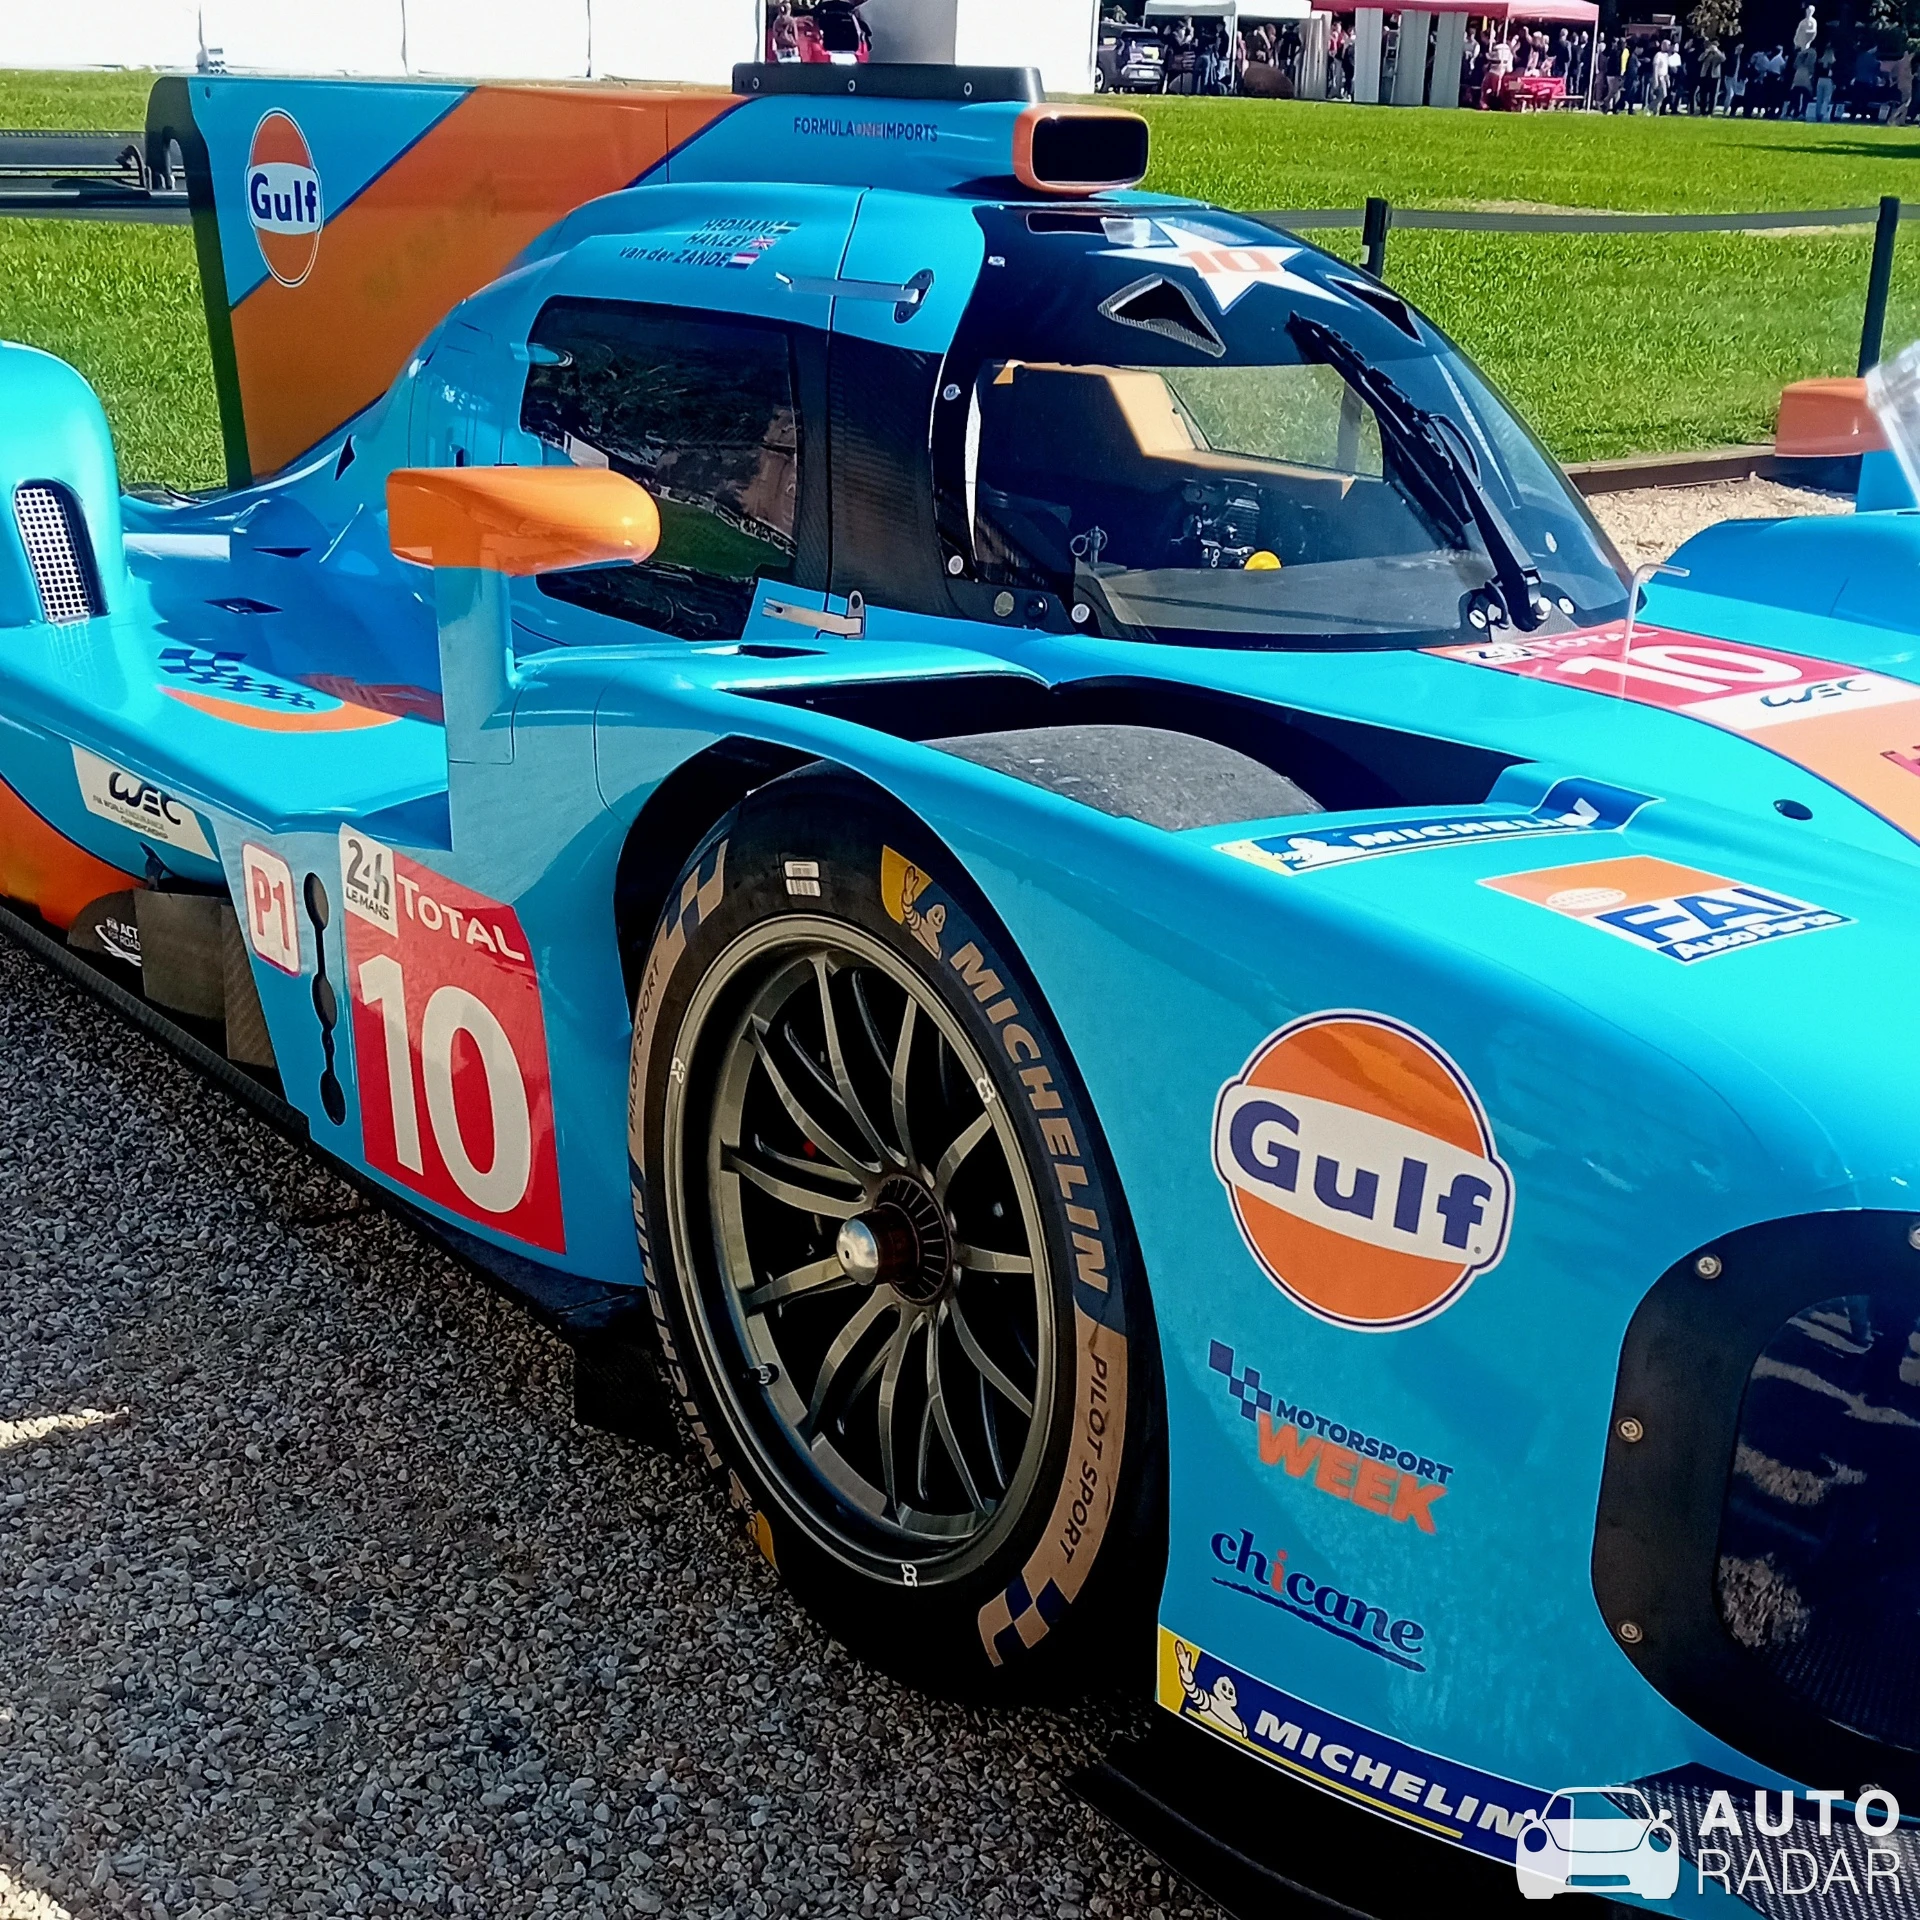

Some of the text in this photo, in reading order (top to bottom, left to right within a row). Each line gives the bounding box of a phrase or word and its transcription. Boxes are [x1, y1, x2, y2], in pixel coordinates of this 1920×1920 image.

[251, 172, 317, 223] Gulf
[619, 246, 732, 268] van der ZANDE
[684, 233, 752, 249] HANLEY
[1179, 250, 1279, 273] 10
[1556, 644, 1803, 694] 10
[1760, 679, 1873, 708] WEC
[109, 771, 181, 826] WEC
[1349, 797, 1601, 847] MICHELIN
[346, 886, 390, 921] LE MANS
[347, 839, 390, 905] 24h
[251, 863, 291, 951] P1
[396, 873, 527, 962] TOTAL
[1594, 887, 1809, 944] FAI
[1671, 926, 1757, 960] Auto
[635, 955, 660, 1046] SPORT
[358, 954, 532, 1213] 10
[949, 941, 1109, 1293] MICHELIN
[1230, 1100, 1493, 1250] Gulf
[1059, 1353, 1108, 1564] PILOT SPORT
[1257, 1410, 1448, 1536] WEEK
[1276, 1399, 1455, 1485] MOTORSPORT
[1210, 1528, 1425, 1654] chicane
[1254, 1709, 1527, 1840] MICHELIN
